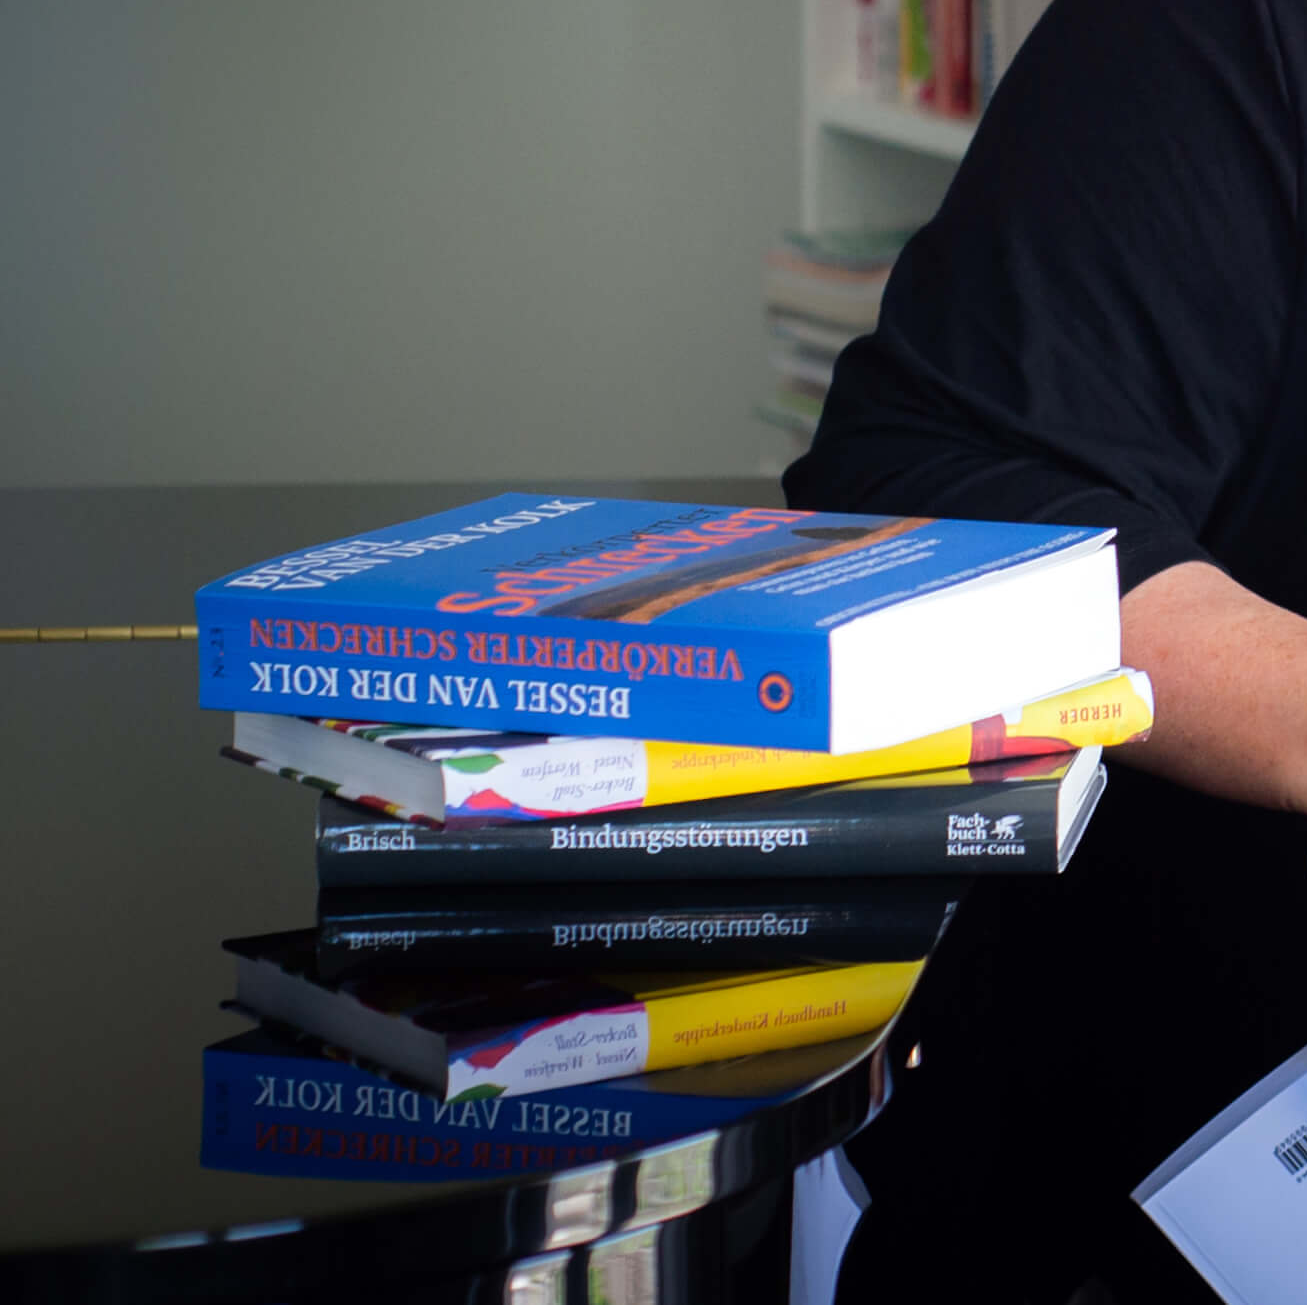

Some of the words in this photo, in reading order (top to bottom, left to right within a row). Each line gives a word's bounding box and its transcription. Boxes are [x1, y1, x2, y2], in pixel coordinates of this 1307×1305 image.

[272, 553, 391, 591] VAN
[392, 532, 462, 558] DER
[466, 500, 597, 536] KOLK
[435, 507, 818, 618] Schrecken
[225, 539, 397, 590] BESSEL
[247, 617, 457, 662] SCHRECKEN
[463, 630, 743, 683] VERKÖRPERTER
[247, 662, 339, 699] KOLK
[346, 668, 416, 706] DER
[426, 674, 499, 710] VAN
[507, 679, 630, 721] BESSEL
[1059, 703, 1124, 726] HERDER
[347, 829, 416, 853] Brisch
[550, 822, 809, 854] Bindungsstörungen
[947, 814, 991, 832] Fach-
[947, 826, 988, 844] buch
[946, 842, 1027, 857] Klett-Cotta
